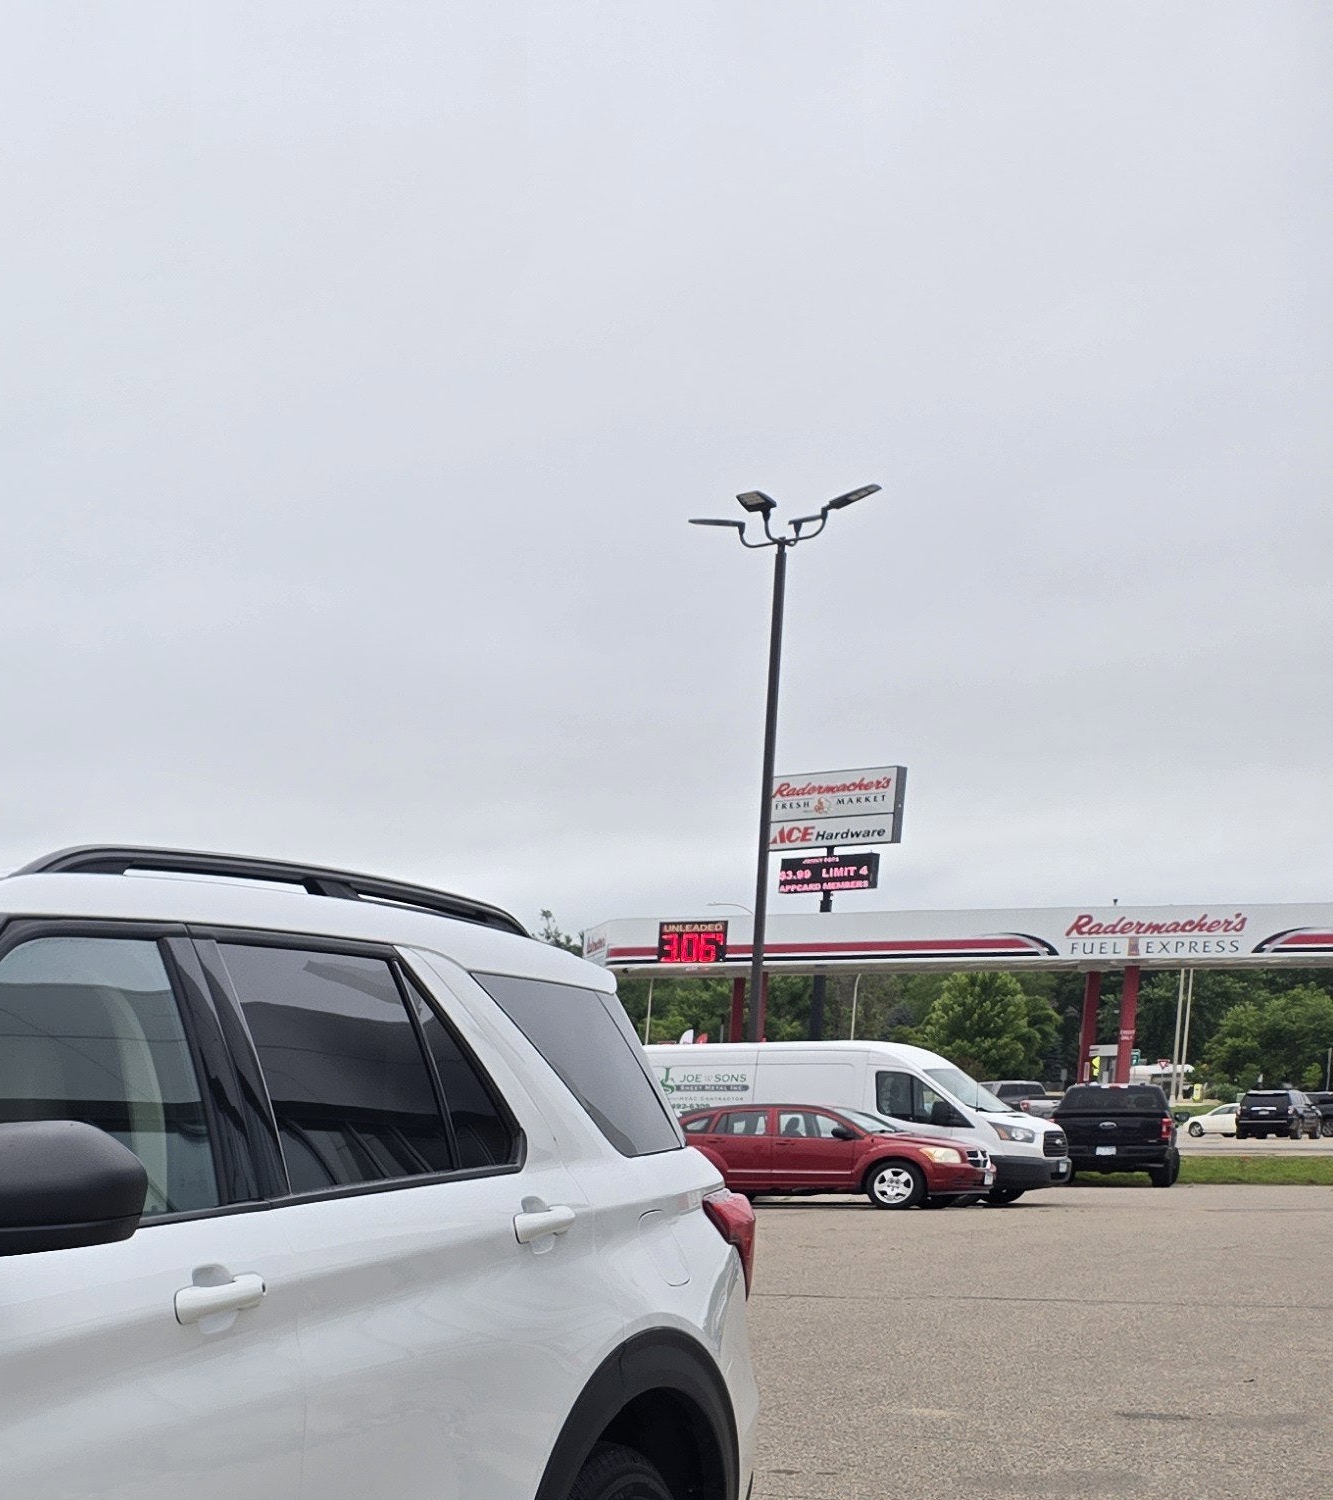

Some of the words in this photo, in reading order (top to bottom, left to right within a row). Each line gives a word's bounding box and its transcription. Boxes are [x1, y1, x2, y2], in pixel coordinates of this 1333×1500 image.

[771, 776, 891, 798] Radermacher's
[775, 800, 810, 810] FRESH
[836, 795, 886, 805] MARKET
[770, 826, 815, 844] ACE
[815, 828, 886, 841] Hardware
[822, 866, 857, 878] LIMIT
[664, 923, 723, 933] UNLEADED
[1065, 912, 1248, 937] Radermacher's
[1070, 941, 1121, 955] FUEL
[1145, 939, 1240, 954] EXPRESS
[679, 1074, 702, 1083] JOE
[714, 1073, 747, 1083] SONS
